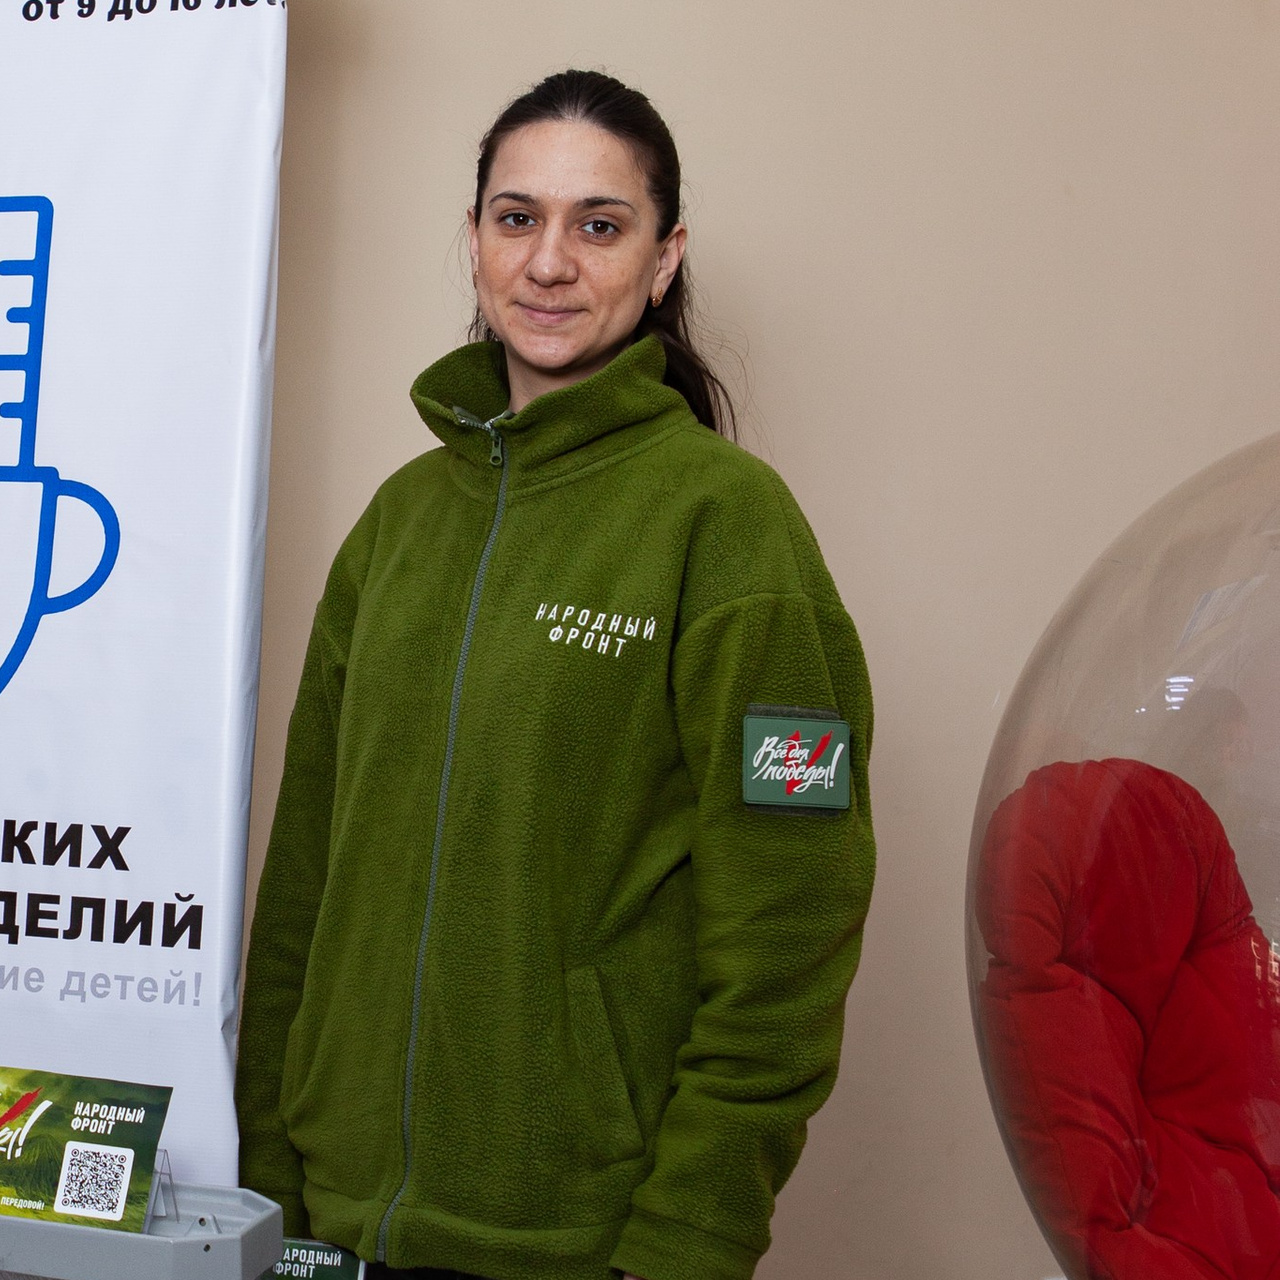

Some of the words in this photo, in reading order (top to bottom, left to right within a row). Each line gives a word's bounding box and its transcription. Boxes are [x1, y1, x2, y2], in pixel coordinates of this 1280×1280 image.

[535, 602, 656, 641] НАРОДНЫЙ
[549, 625, 626, 657] ФРОНТ
[762, 743, 844, 793] победы!
[59, 968, 204, 1008] детей!
[73, 1101, 146, 1124] НАРОДНЫЙ
[71, 1117, 115, 1136] ФРОНТ
[1, 1196, 45, 1211] ПЕРЕДОВОЙ!
[283, 1247, 342, 1266] АРОДНЫЙ
[273, 1261, 315, 1278] ФРОНТ
